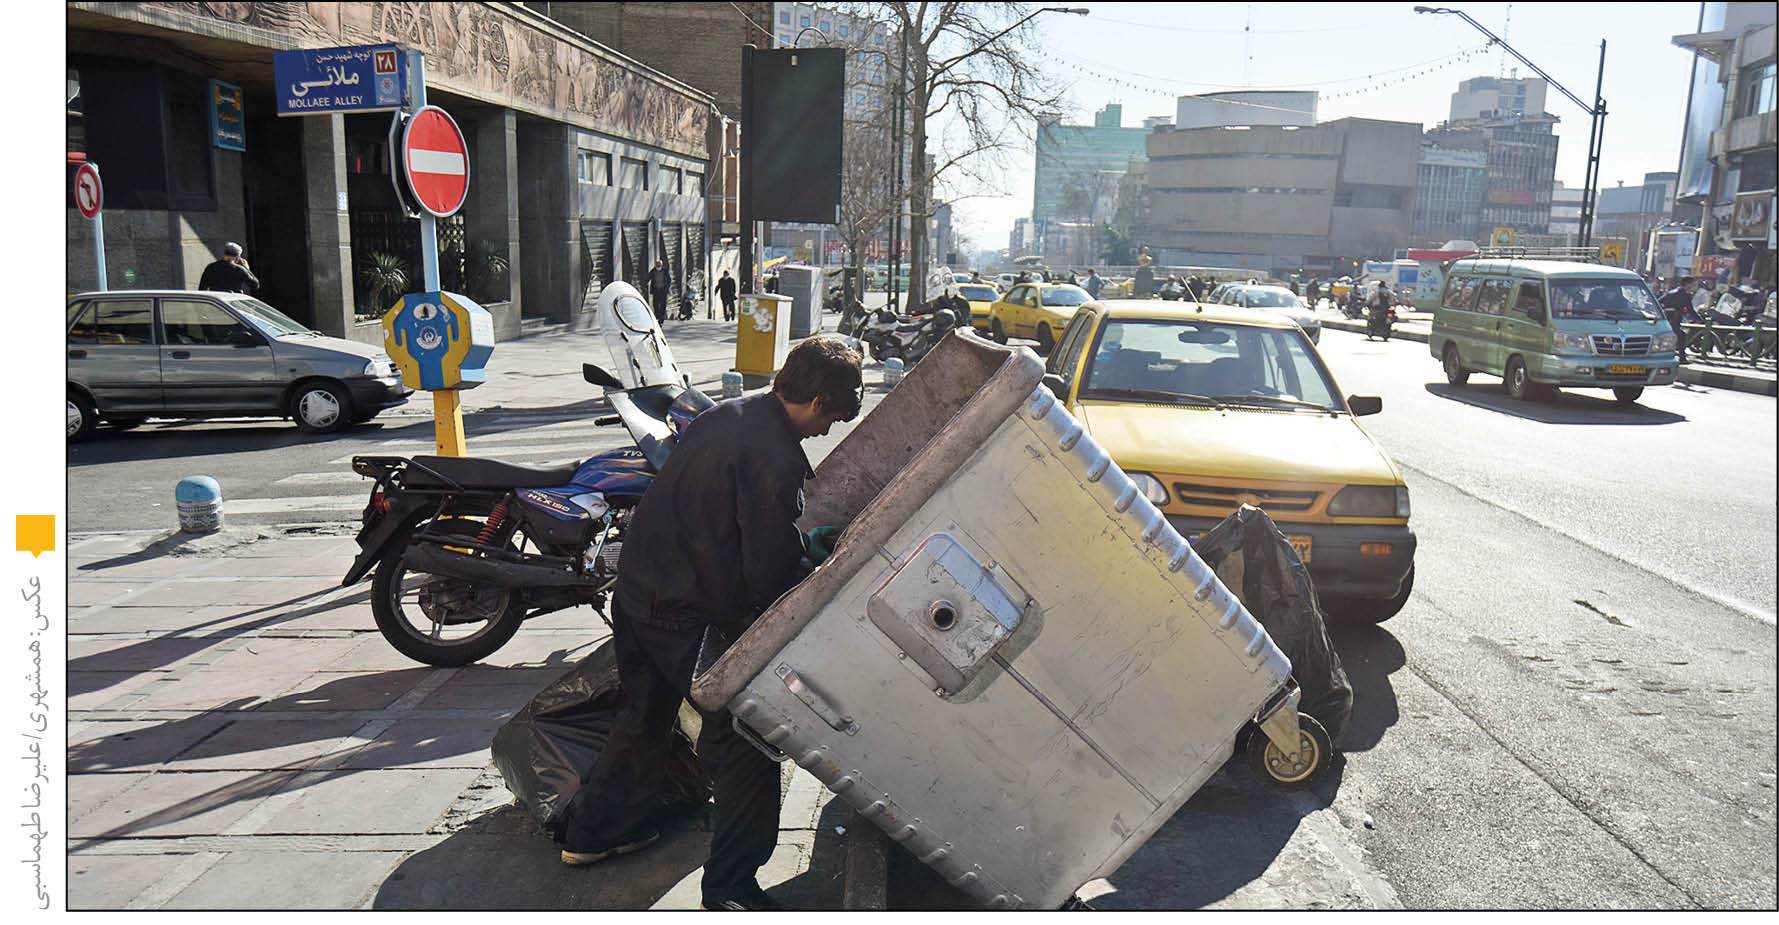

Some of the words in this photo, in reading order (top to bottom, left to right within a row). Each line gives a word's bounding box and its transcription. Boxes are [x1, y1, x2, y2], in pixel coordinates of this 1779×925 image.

[334, 51, 353, 63] شهید
[354, 50, 372, 62] کوچه
[377, 54, 394, 71] ۲۸
[288, 97, 331, 109] MOLLAEE
[334, 95, 363, 106] ALLEY
